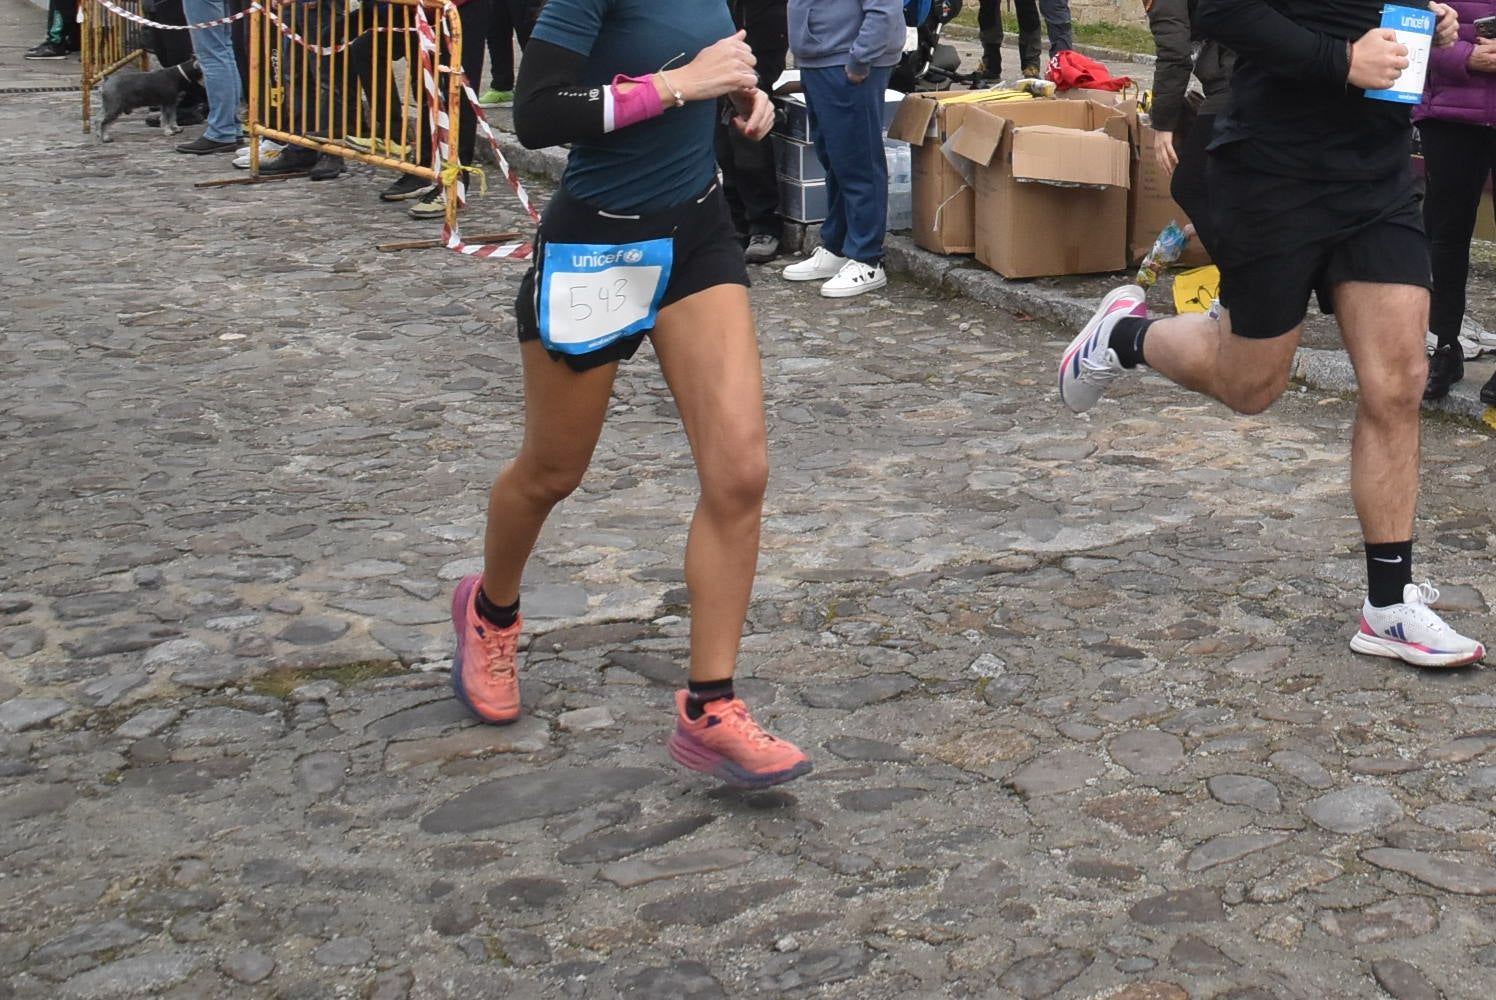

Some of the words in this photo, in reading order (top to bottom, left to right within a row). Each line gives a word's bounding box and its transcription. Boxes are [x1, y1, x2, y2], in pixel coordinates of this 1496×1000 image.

[1401, 13, 1426, 29] unicef
[572, 250, 624, 268] unicef
[569, 278, 629, 322] 543
